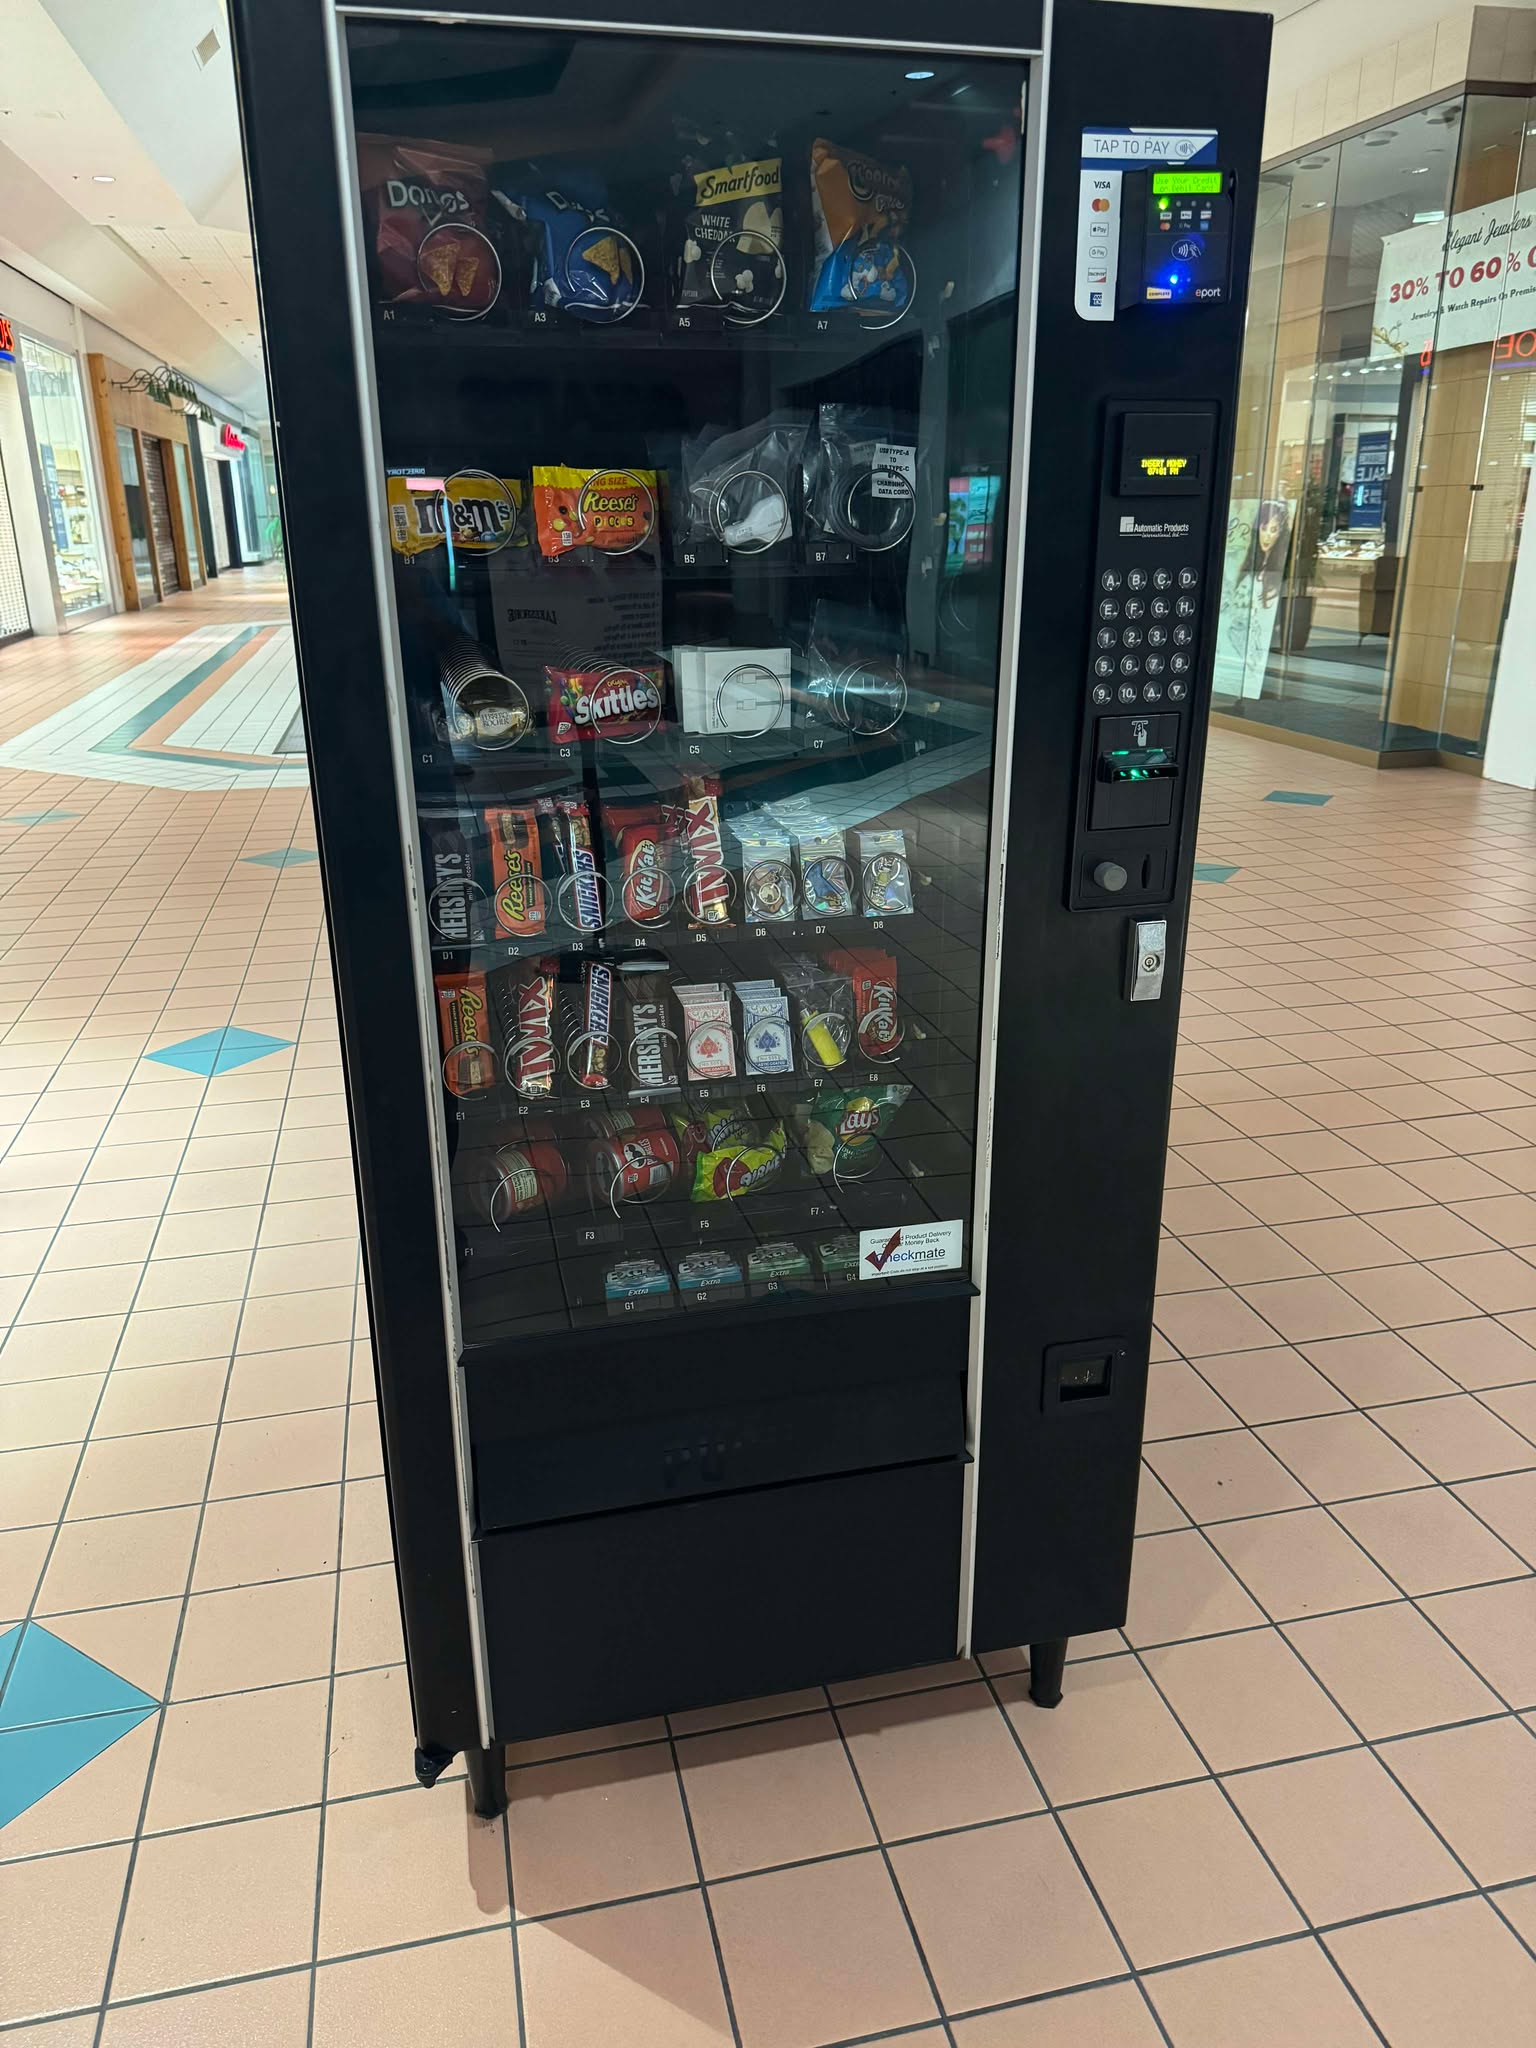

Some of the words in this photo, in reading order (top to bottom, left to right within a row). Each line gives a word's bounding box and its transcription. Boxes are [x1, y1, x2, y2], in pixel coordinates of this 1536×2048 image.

[1094, 139, 1120, 153] TAP
[1123, 140, 1140, 154] TO
[1144, 141, 1170, 154] PAY
[700, 165, 780, 199] Smartfood
[1156, 176, 1169, 184] Use
[1192, 175, 1217, 184] Credit
[1093, 180, 1111, 189] VISA
[701, 214, 731, 229] WHITE
[1097, 226, 1107, 234] Pay
[1195, 287, 1221, 298] eport
[1389, 276, 1429, 304] 30%
[1410, 309, 1437, 321] Jewelry
[1447, 301, 1469, 314] Watch
[1470, 295, 1497, 309] Repairs
[383, 310, 395, 321] A1
[534, 312, 546, 322] A3
[678, 317, 691, 327] A5
[817, 320, 829, 331] A7
[1141, 458, 1164, 468] INSERT
[1166, 458, 1187, 468] MONEY
[1169, 467, 1179, 475] PM
[608, 476, 628, 486] SIZE
[583, 491, 638, 513] Reese's
[1134, 523, 1163, 533] Automatic
[1164, 523, 1189, 532] Products
[684, 553, 696, 564] B5
[815, 552, 826, 562] B7
[1107, 575, 1115, 586] A
[1132, 574, 1140, 585] B
[1157, 573, 1166, 585] C
[1182, 573, 1191, 584] D
[1105, 604, 1112, 615] E
[1130, 603, 1138, 614] F
[1155, 602, 1164, 613] G
[1181, 601, 1189, 612] H
[1128, 632, 1135, 642] 2
[1153, 631, 1160, 641] 3
[1178, 630, 1185, 640] 4
[1121, 688, 1132, 698] 10
[574, 685, 659, 725] Skittles
[813, 740, 824, 749] C7
[560, 748, 571, 757] C3
[689, 745, 700, 754] C5
[422, 754, 433, 764] C1
[685, 801, 730, 918] TWIX
[501, 850, 526, 921] Reese's
[435, 853, 468, 938] HERSHEY'S
[815, 925, 826, 934] D7
[873, 921, 884, 930] D8
[756, 928, 766, 937] D6
[696, 933, 707, 942] D5
[572, 942, 583, 951] D3
[635, 938, 646, 947] D4
[442, 952, 454, 960] D1
[508, 947, 519, 956] D2
[591, 965, 610, 1043] SNICKERS
[516, 976, 556, 1088] TWIX
[632, 1004, 663, 1084] HERSHEY'S
[869, 1074, 878, 1082] E8
[814, 1079, 824, 1087] E7
[756, 1084, 766, 1093] E6
[699, 1090, 709, 1098] E5
[580, 1100, 591, 1108] E3
[640, 1096, 649, 1104] E4
[518, 1106, 528, 1114] E2
[456, 1112, 465, 1120] E1
[810, 1208, 819, 1216] F7
[700, 1220, 709, 1228] F5
[585, 1232, 595, 1240] F3
[928, 1230, 952, 1238] Delivery
[464, 1248, 473, 1256] F1
[769, 1269, 790, 1278] Extra
[846, 1273, 856, 1281] G4
[700, 1279, 721, 1287] Extra
[768, 1282, 778, 1290] G3
[628, 1288, 649, 1296] Extra
[697, 1292, 707, 1301] G2
[625, 1302, 635, 1310] G1
